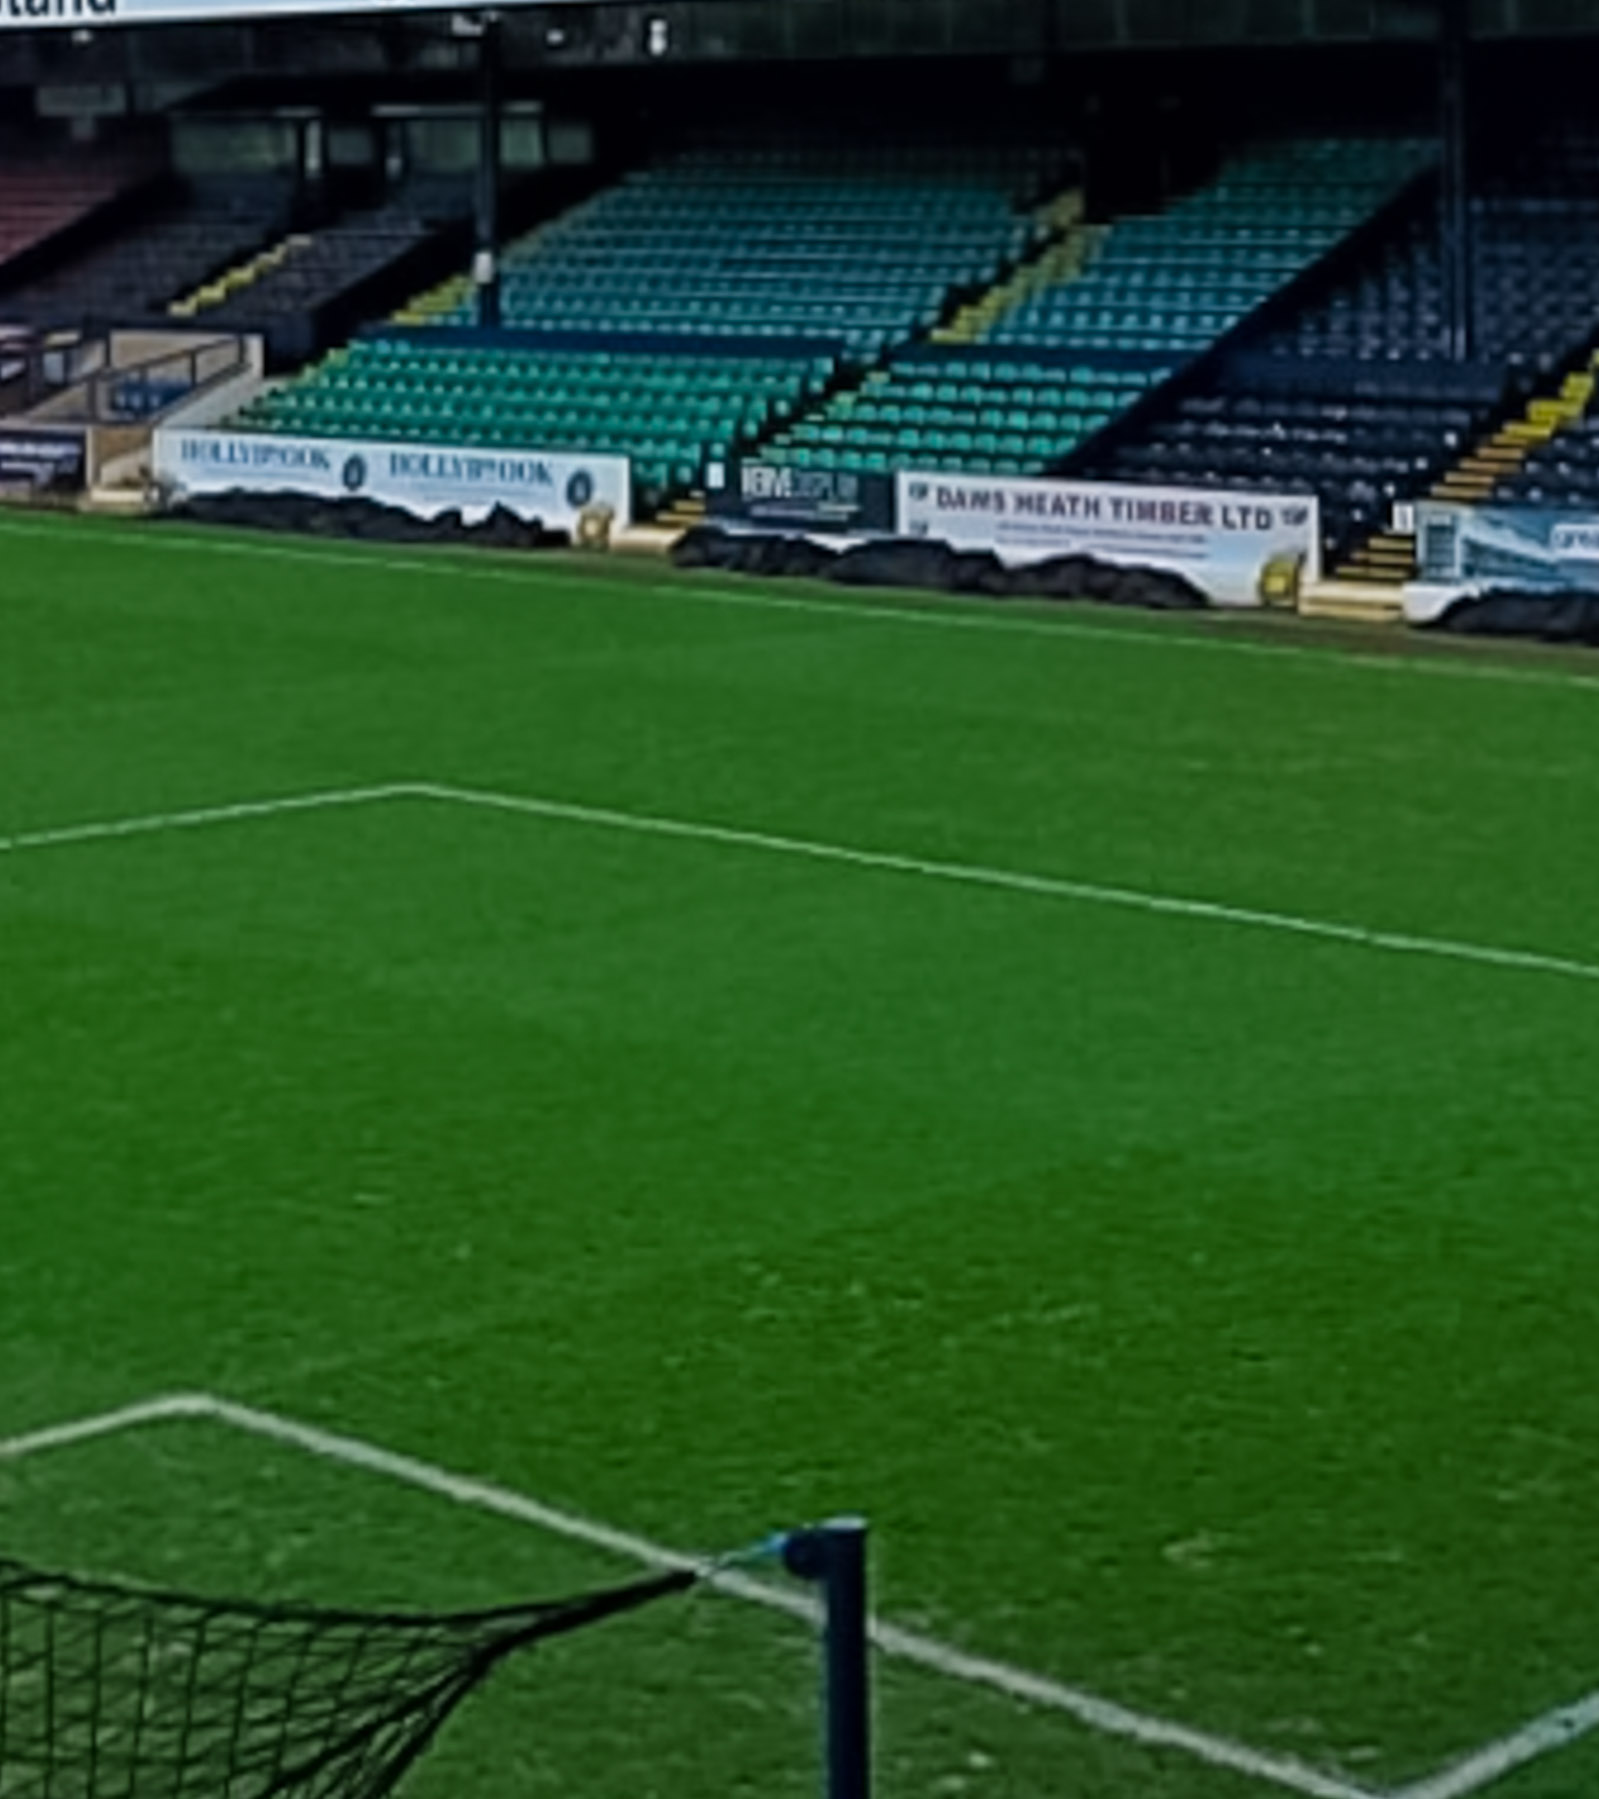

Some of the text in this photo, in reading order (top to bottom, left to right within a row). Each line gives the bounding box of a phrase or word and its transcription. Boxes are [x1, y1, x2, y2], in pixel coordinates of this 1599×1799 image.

[1013, 490, 1101, 520] HEATH
[1109, 495, 1214, 527] TIMBER
[1221, 504, 1274, 531] LTD
